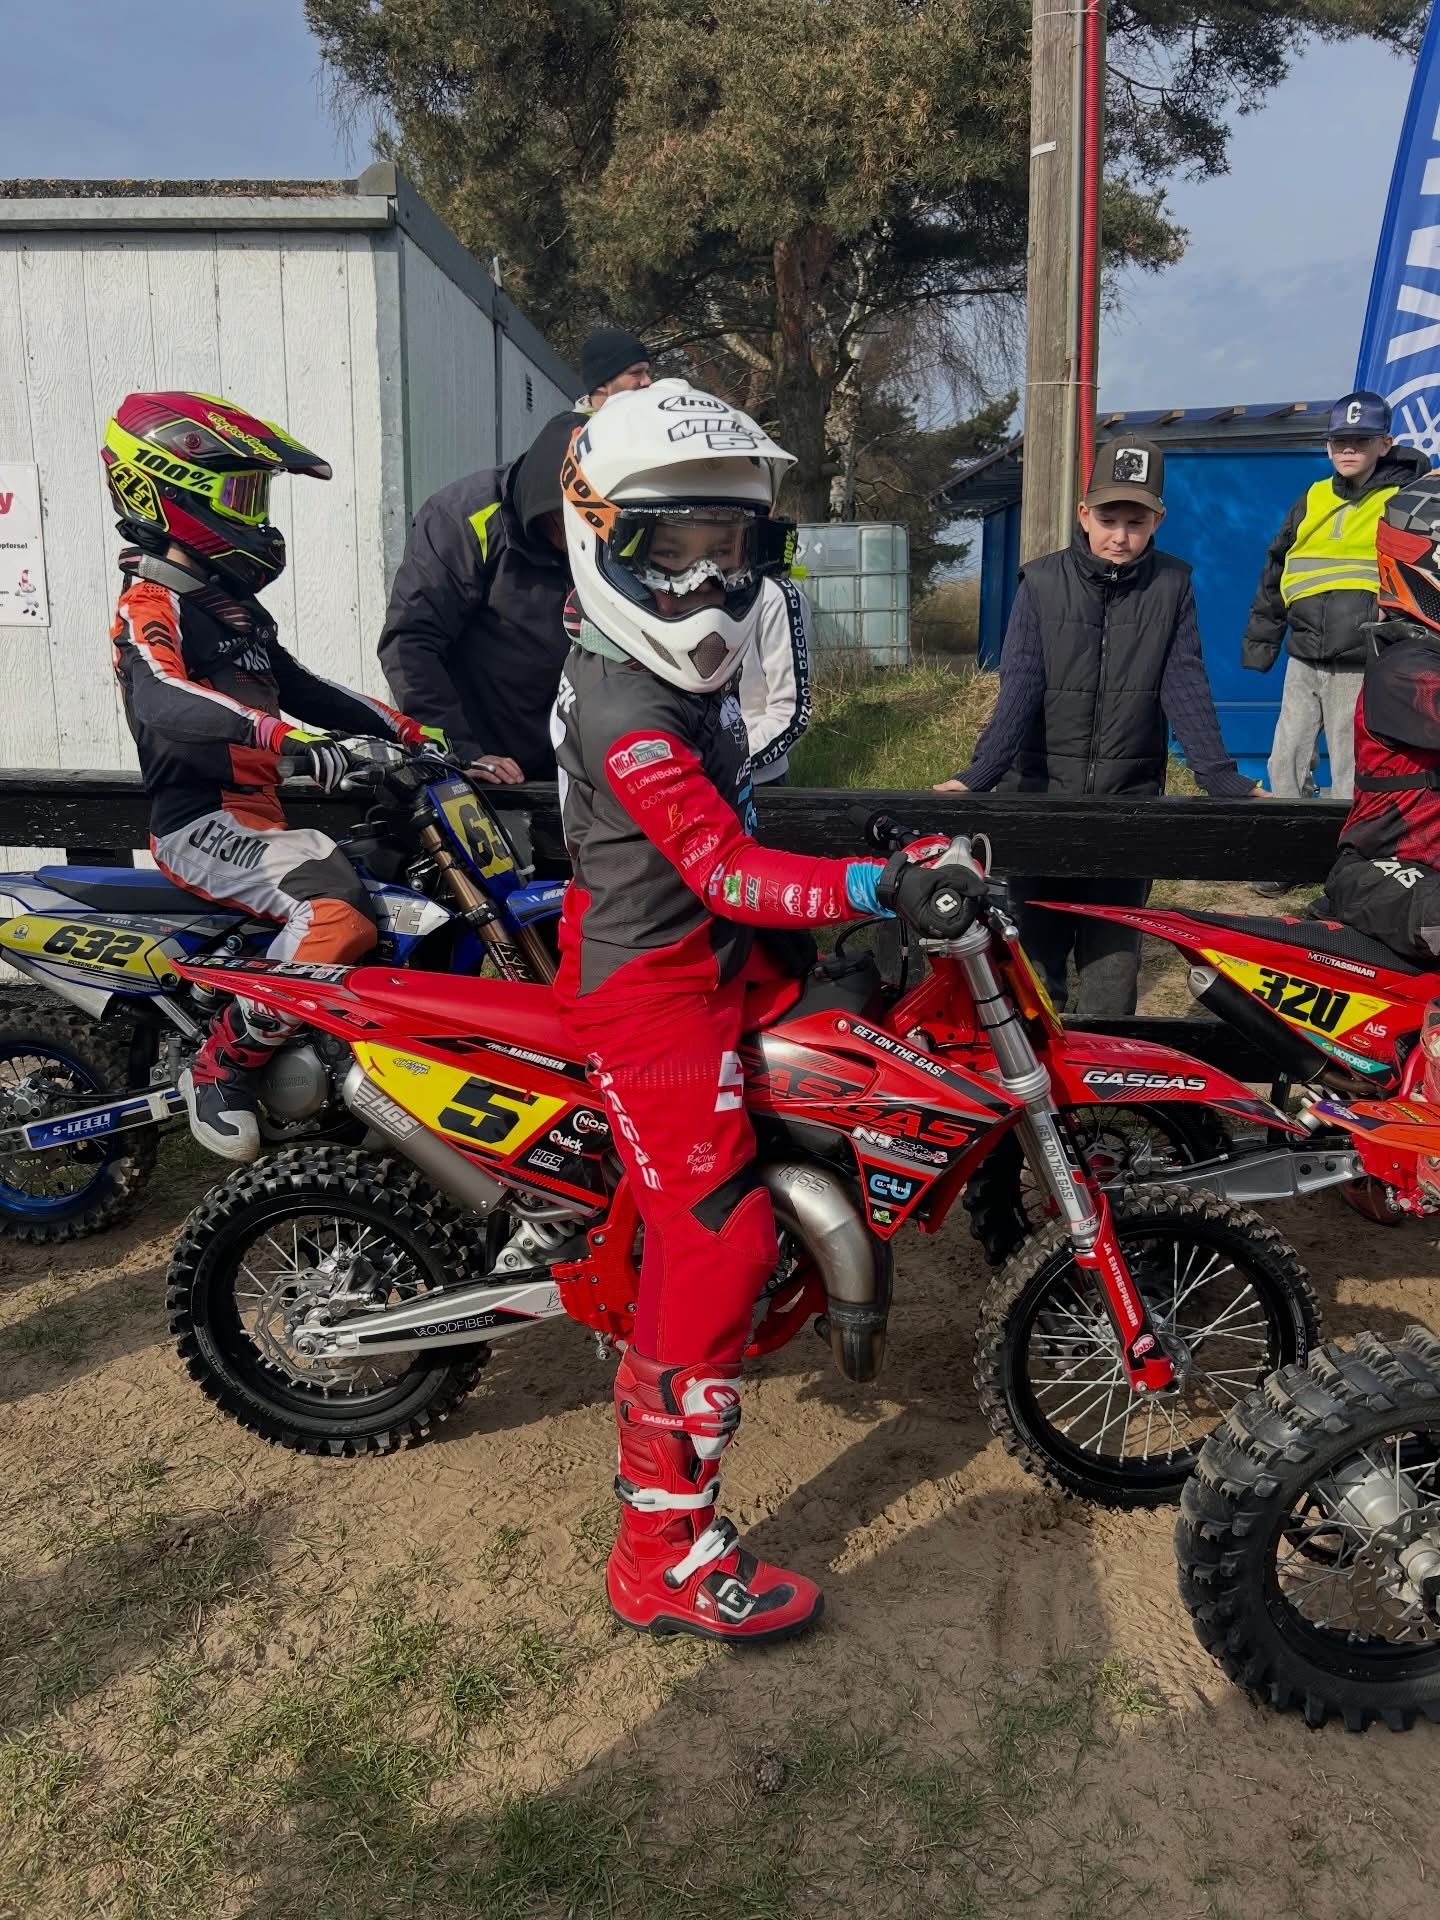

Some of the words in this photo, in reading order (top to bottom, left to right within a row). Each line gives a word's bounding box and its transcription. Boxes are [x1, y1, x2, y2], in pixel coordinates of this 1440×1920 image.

[658, 396, 729, 413] Arai
[1346, 401, 1362, 425] C
[705, 433, 758, 451] 5
[133, 448, 217, 493] 100%
[783, 529, 797, 565] 100%
[793, 616, 808, 670] HOUND
[611, 751, 637, 776] MIGA
[634, 766, 683, 791] LokalBolig
[188, 819, 271, 870] WICKED
[745, 874, 760, 911] HGS
[806, 887, 819, 918] Quick
[43, 924, 145, 968] 632
[1308, 951, 1376, 979] MOTOTASSINARI
[1252, 967, 1351, 1033] 320
[507, 1047, 567, 1071] RASMUSSEN
[853, 1025, 878, 1040] GET
[874, 1036, 895, 1050] ON
[892, 1045, 919, 1062] THE
[914, 1057, 947, 1078] GAS!
[1333, 1047, 1374, 1071] MOTOREX
[1082, 1070, 1207, 1091] GASGAS
[369, 1095, 420, 1134] HGS
[437, 1076, 540, 1144] 5
[52, 1112, 111, 1136] S-TEEL
[578, 1115, 609, 1133] NOR
[1037, 1124, 1051, 1141] GET
[549, 1129, 584, 1152] Quick
[1045, 1144, 1057, 1158] ON
[531, 1149, 565, 1168] HGS
[687, 1153, 718, 1166] RACING
[1049, 1160, 1066, 1178] THE
[778, 1164, 831, 1195] HGS
[1056, 1180, 1075, 1200] GAS!
[1103, 1242, 1113, 1256] JA
[642, 1414, 684, 1427] GASGAS
